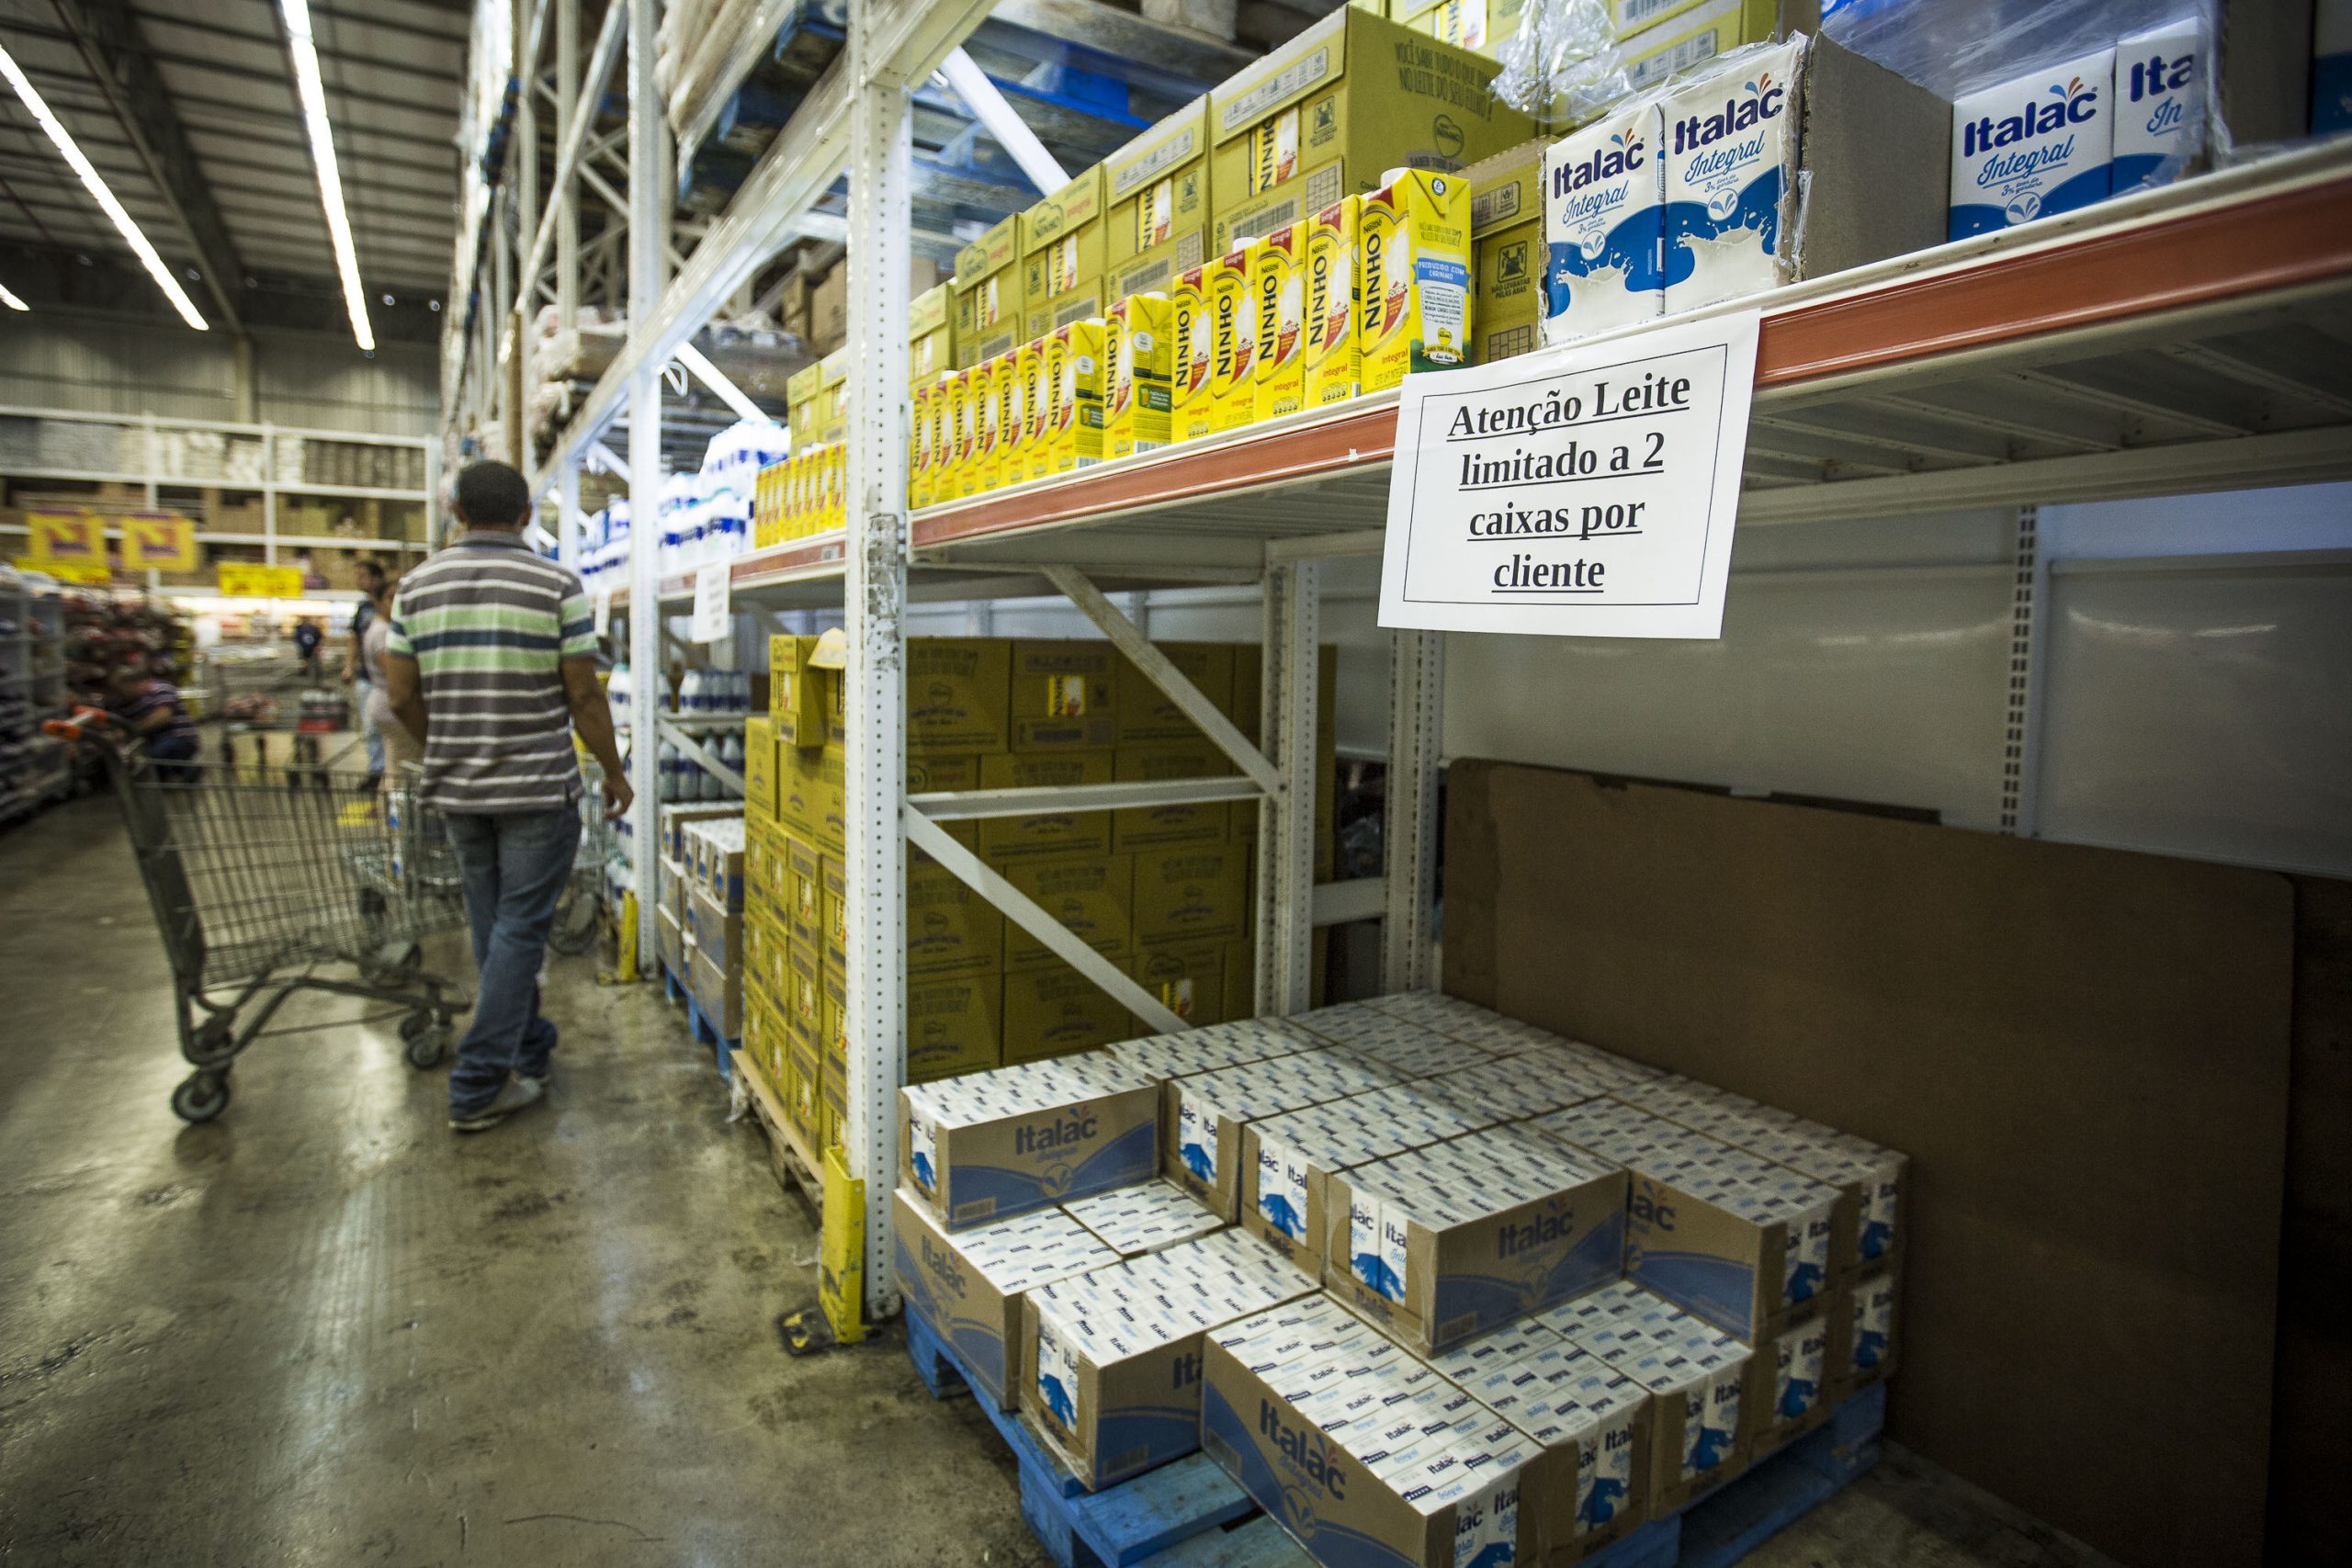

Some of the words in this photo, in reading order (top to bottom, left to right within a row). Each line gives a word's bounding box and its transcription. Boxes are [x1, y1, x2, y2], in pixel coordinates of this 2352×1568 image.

[1674, 87, 1783, 155] Italac
[1963, 92, 2098, 158] Italac
[1554, 141, 1645, 199] Italac
[1684, 130, 1765, 183] Integral
[1976, 133, 2075, 180] Integral
[1563, 180, 1629, 225] Integral
[1364, 232, 1381, 332] NINHO
[1418, 261, 1450, 273] PRODUZIDO
[1451, 265, 1465, 275] COM
[1260, 275, 1277, 361] NINHO
[1309, 255, 1327, 346] NINHO
[1176, 310, 1190, 389] NINHO
[1217, 295, 1232, 378] NINHO
[1051, 361, 1060, 427] NINHO
[1105, 338, 1117, 409] NINHO
[1026, 372, 1035, 434] NINHO
[1448, 390, 1582, 436] Atenção
[1592, 372, 1691, 417] Leite
[1460, 441, 1598, 487] limitado
[1610, 446, 1630, 471] a
[1643, 432, 1665, 469] 2
[1469, 502, 1569, 536] caixas
[1580, 501, 1645, 540] por
[1493, 553, 1605, 588] cliente
[1015, 1116, 1098, 1156] Italac
[1498, 1208, 1575, 1260] Italac
[922, 1235, 967, 1299] Italac
[1346, 1393, 1376, 1411] Italac
[1261, 1398, 1346, 1501] Italac
[1385, 1423, 1416, 1440] Italac
[1485, 1425, 1516, 1443] Italac
[1427, 1456, 1459, 1475] Italac
